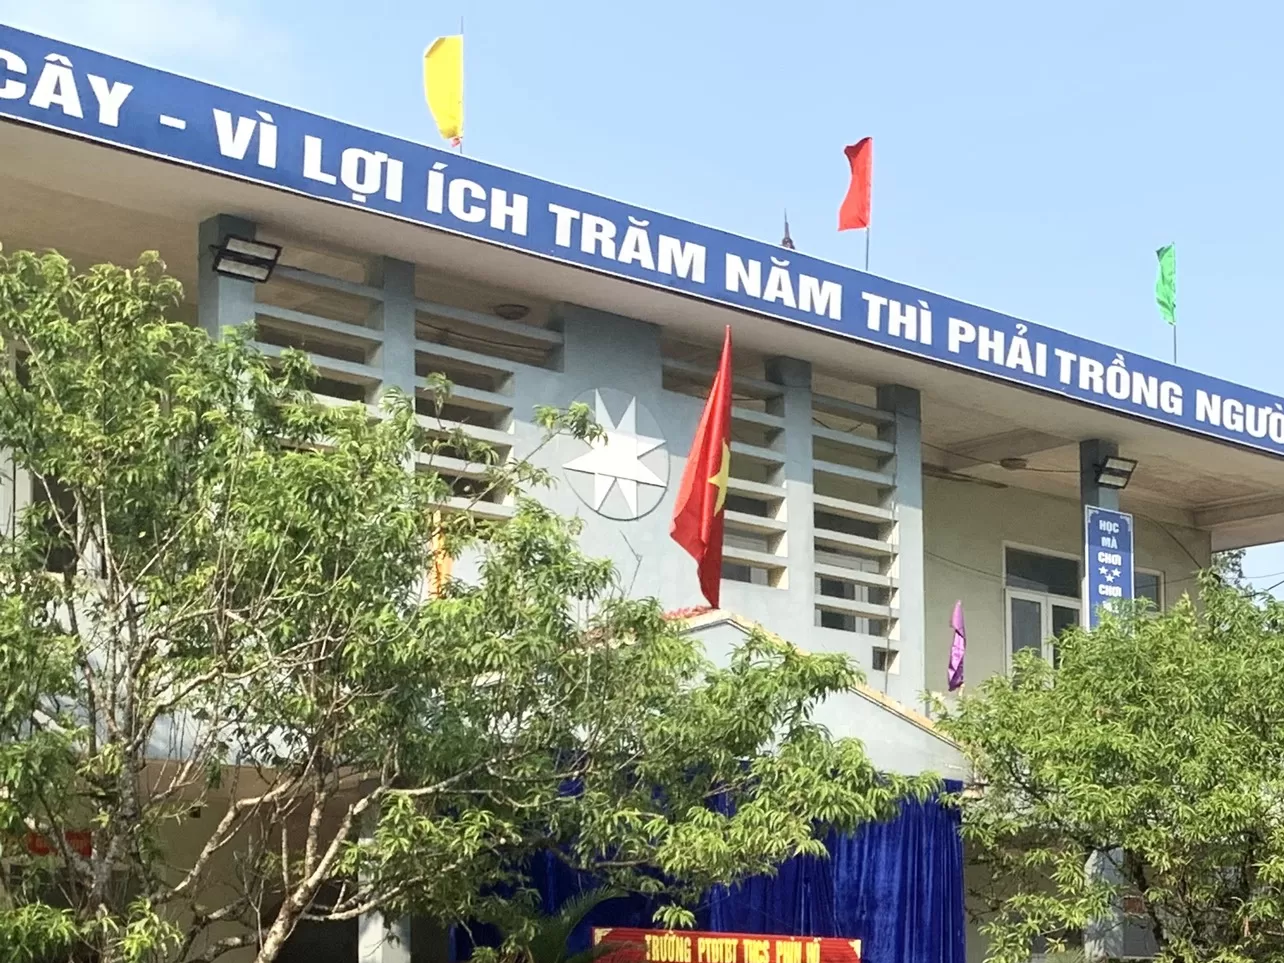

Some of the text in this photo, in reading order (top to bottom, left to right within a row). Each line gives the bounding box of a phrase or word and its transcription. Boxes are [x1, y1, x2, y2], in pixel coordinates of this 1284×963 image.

[0, 49, 133, 127] CÂY
[160, 115, 185, 129] -
[213, 109, 277, 168] VÌ
[303, 135, 403, 203] LỢI
[427, 162, 528, 236] ÍCH
[549, 204, 706, 283] TRĂM
[726, 253, 842, 320] NĂM
[862, 292, 932, 344] THÌ
[948, 317, 1047, 377] PHẢI
[1055, 348, 1183, 416] TRỒNG
[1099, 519, 1119, 534] HỌC
[1101, 535, 1118, 549] MÀ
[645, 930, 692, 963] TRƯỜNG
